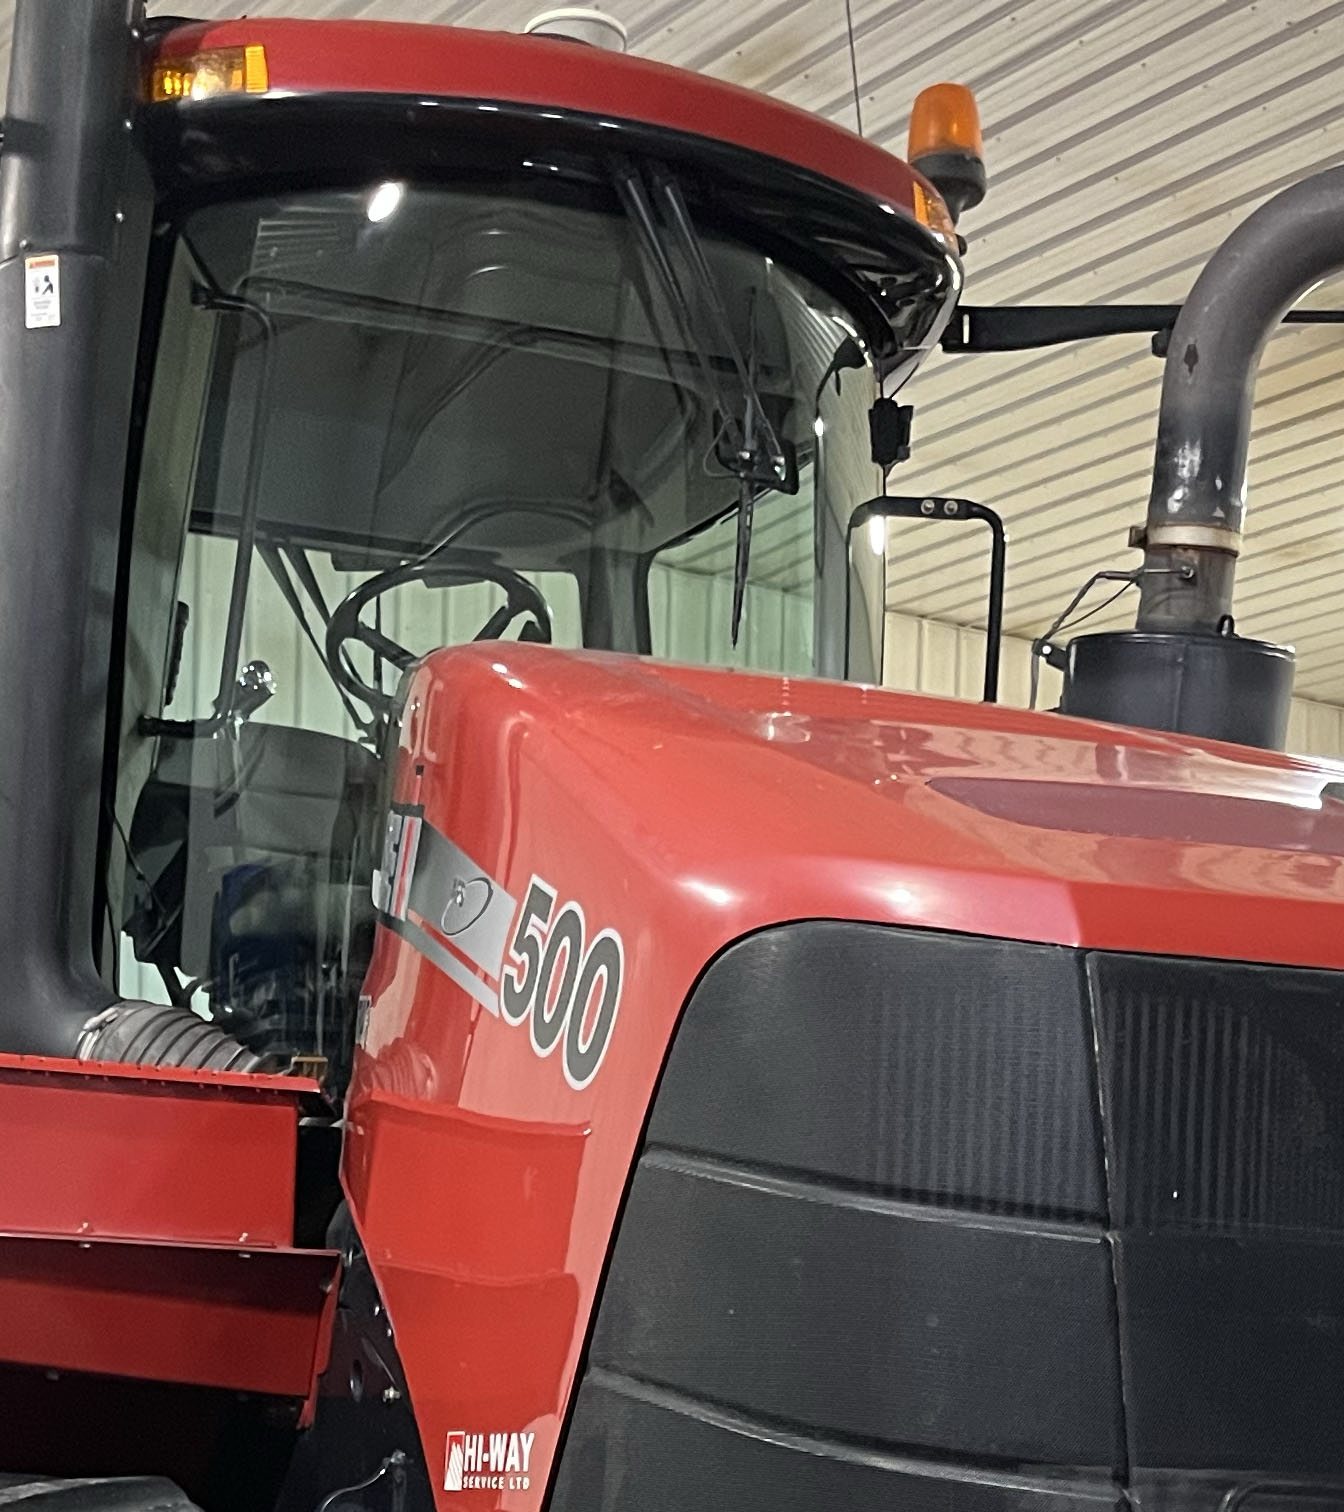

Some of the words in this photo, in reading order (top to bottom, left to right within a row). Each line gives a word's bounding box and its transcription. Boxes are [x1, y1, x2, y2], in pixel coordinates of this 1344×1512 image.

[500, 873, 624, 1090] 500
[463, 1432, 535, 1472] HI-WAY
[462, 1475, 505, 1490] SERVICE
[509, 1476, 531, 1490] LTD
